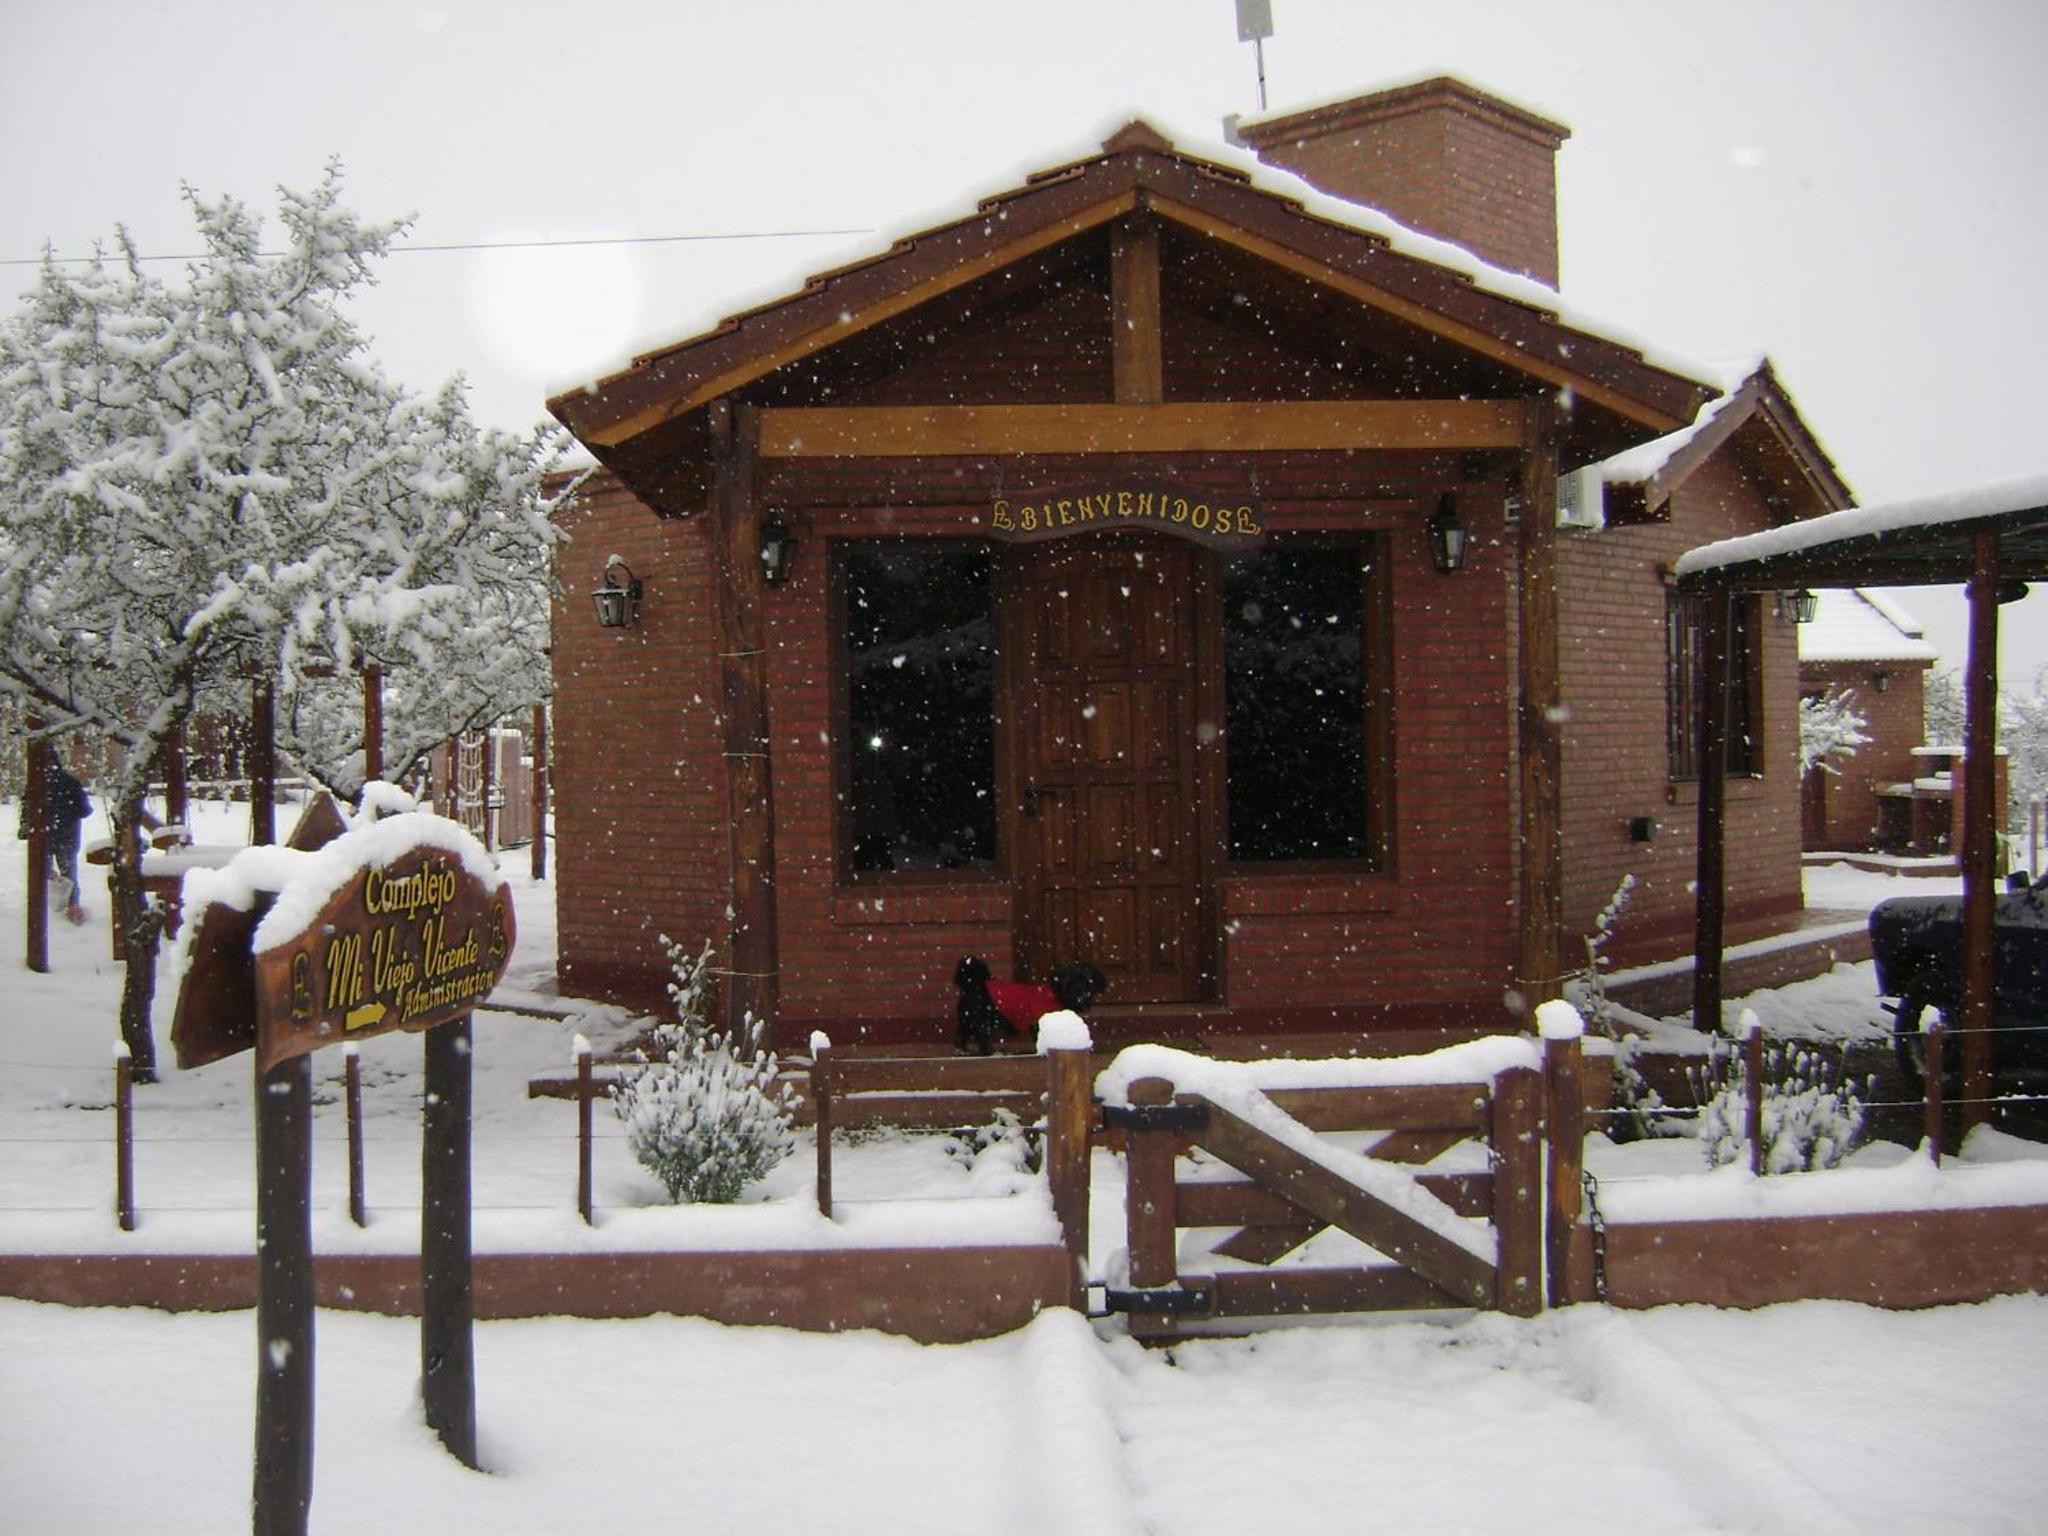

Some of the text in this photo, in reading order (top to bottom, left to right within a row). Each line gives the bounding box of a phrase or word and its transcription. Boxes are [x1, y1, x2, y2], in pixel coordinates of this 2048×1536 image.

[1020, 491, 1232, 533] BIENVENIDOS
[365, 857, 456, 920] Complejo
[327, 915, 479, 1009] Mi Viejo Vicente
